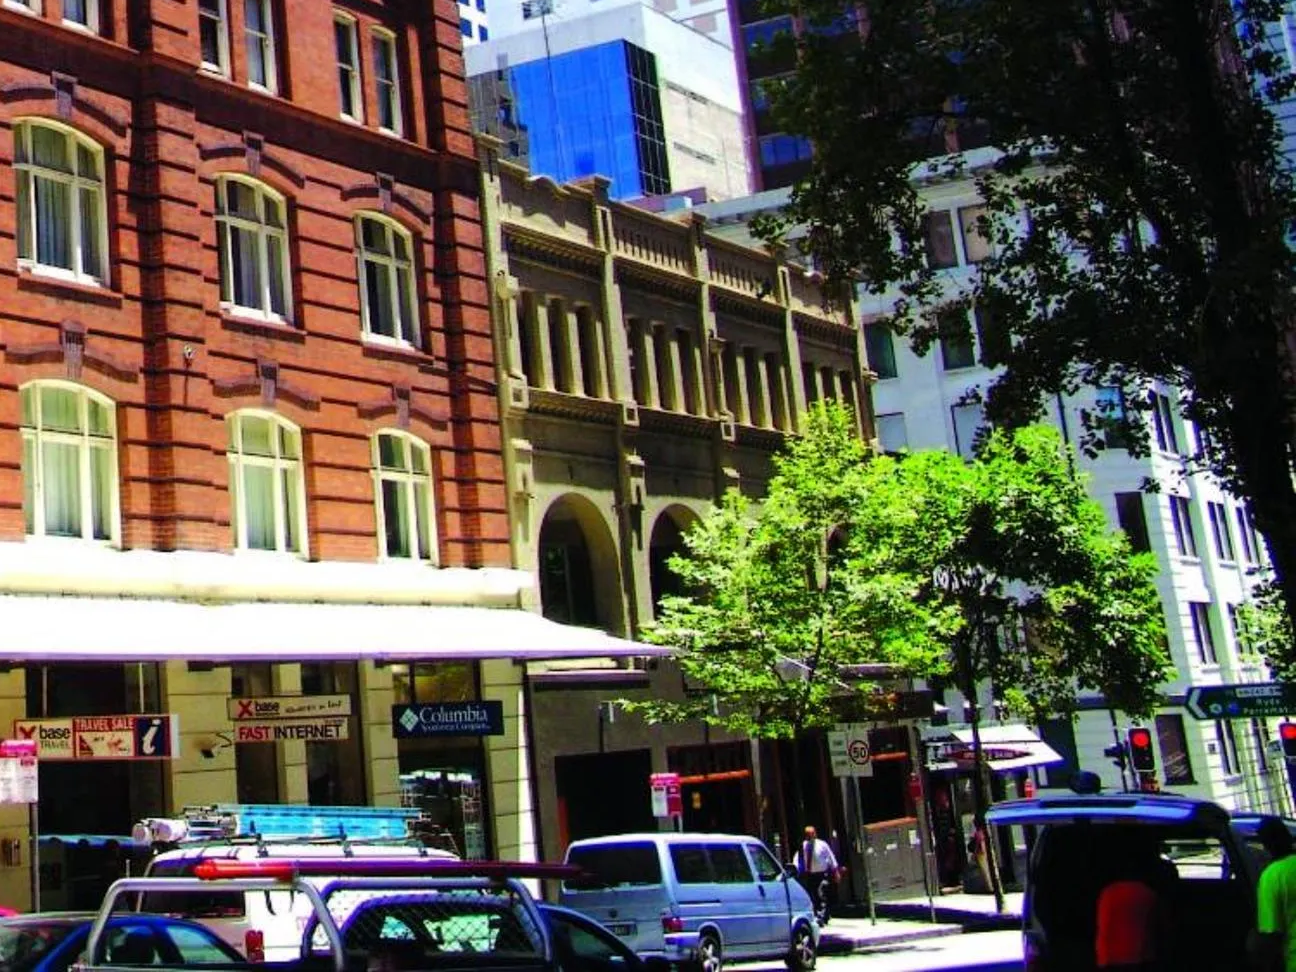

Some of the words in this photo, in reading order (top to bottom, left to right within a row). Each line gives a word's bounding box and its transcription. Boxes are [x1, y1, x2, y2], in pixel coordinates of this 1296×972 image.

[254, 700, 281, 712] base
[420, 704, 489, 723] Columbia
[39, 724, 71, 740] base
[75, 719, 109, 732] TRAVEL
[112, 717, 135, 730] SALE
[239, 725, 270, 740] FAST
[274, 724, 342, 739] INTERNET
[40, 740, 70, 750] TRAVEL
[853, 747, 866, 759] 50
